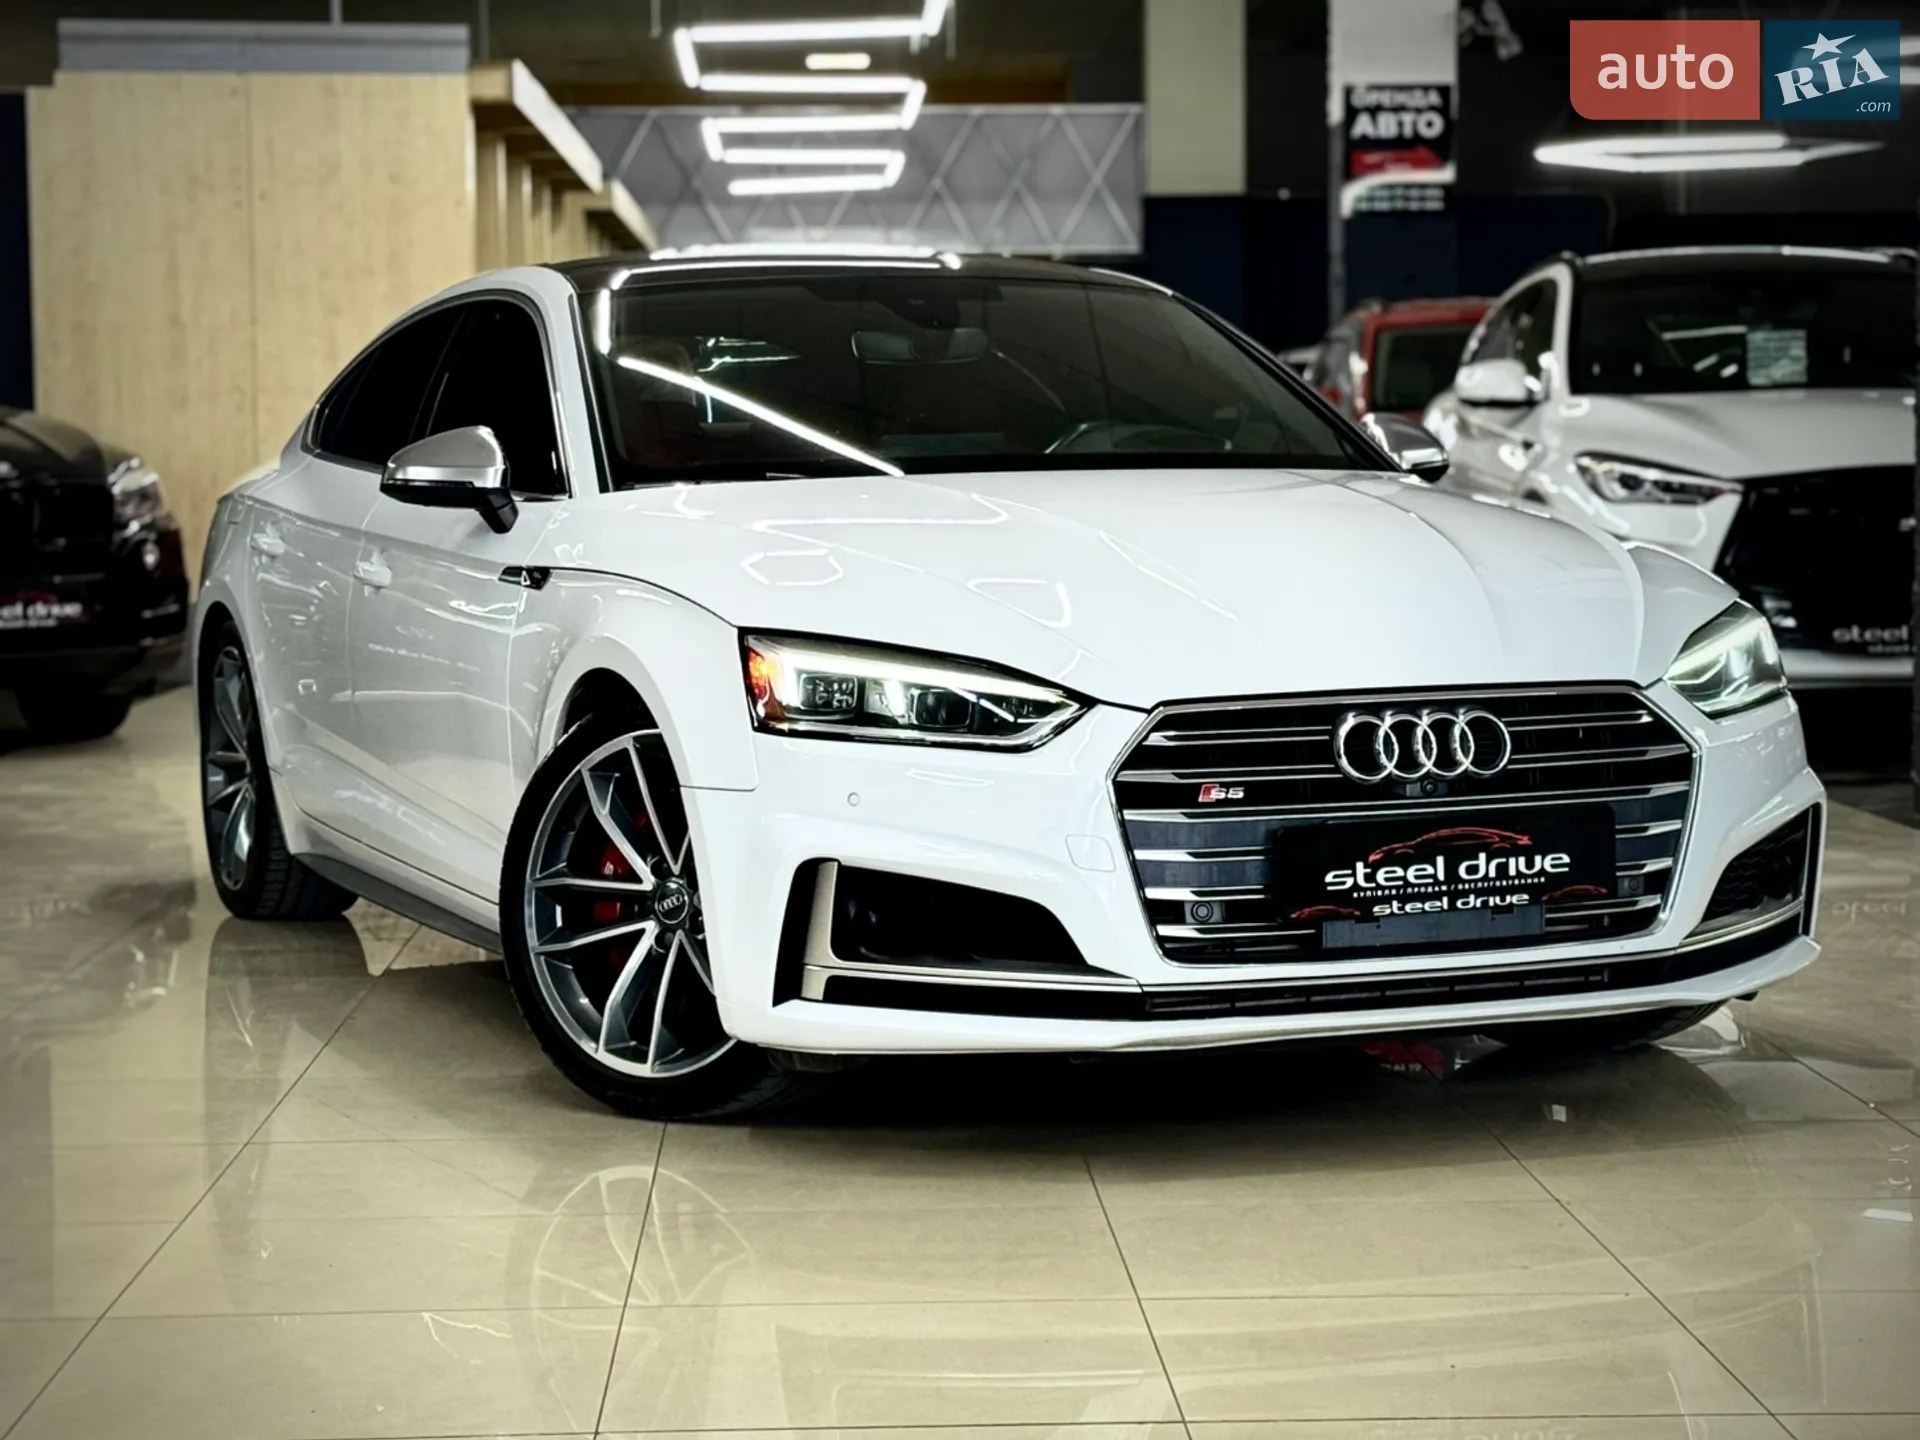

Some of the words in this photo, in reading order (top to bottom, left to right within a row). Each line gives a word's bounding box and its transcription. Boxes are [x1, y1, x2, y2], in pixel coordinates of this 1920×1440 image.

[1349, 110, 1445, 139] АВТО
[1210, 786, 1245, 799] S5
[1324, 855, 1445, 891] steel
[1458, 852, 1571, 881] drive
[1373, 896, 1448, 916] steel
[1456, 893, 1530, 910] drive
